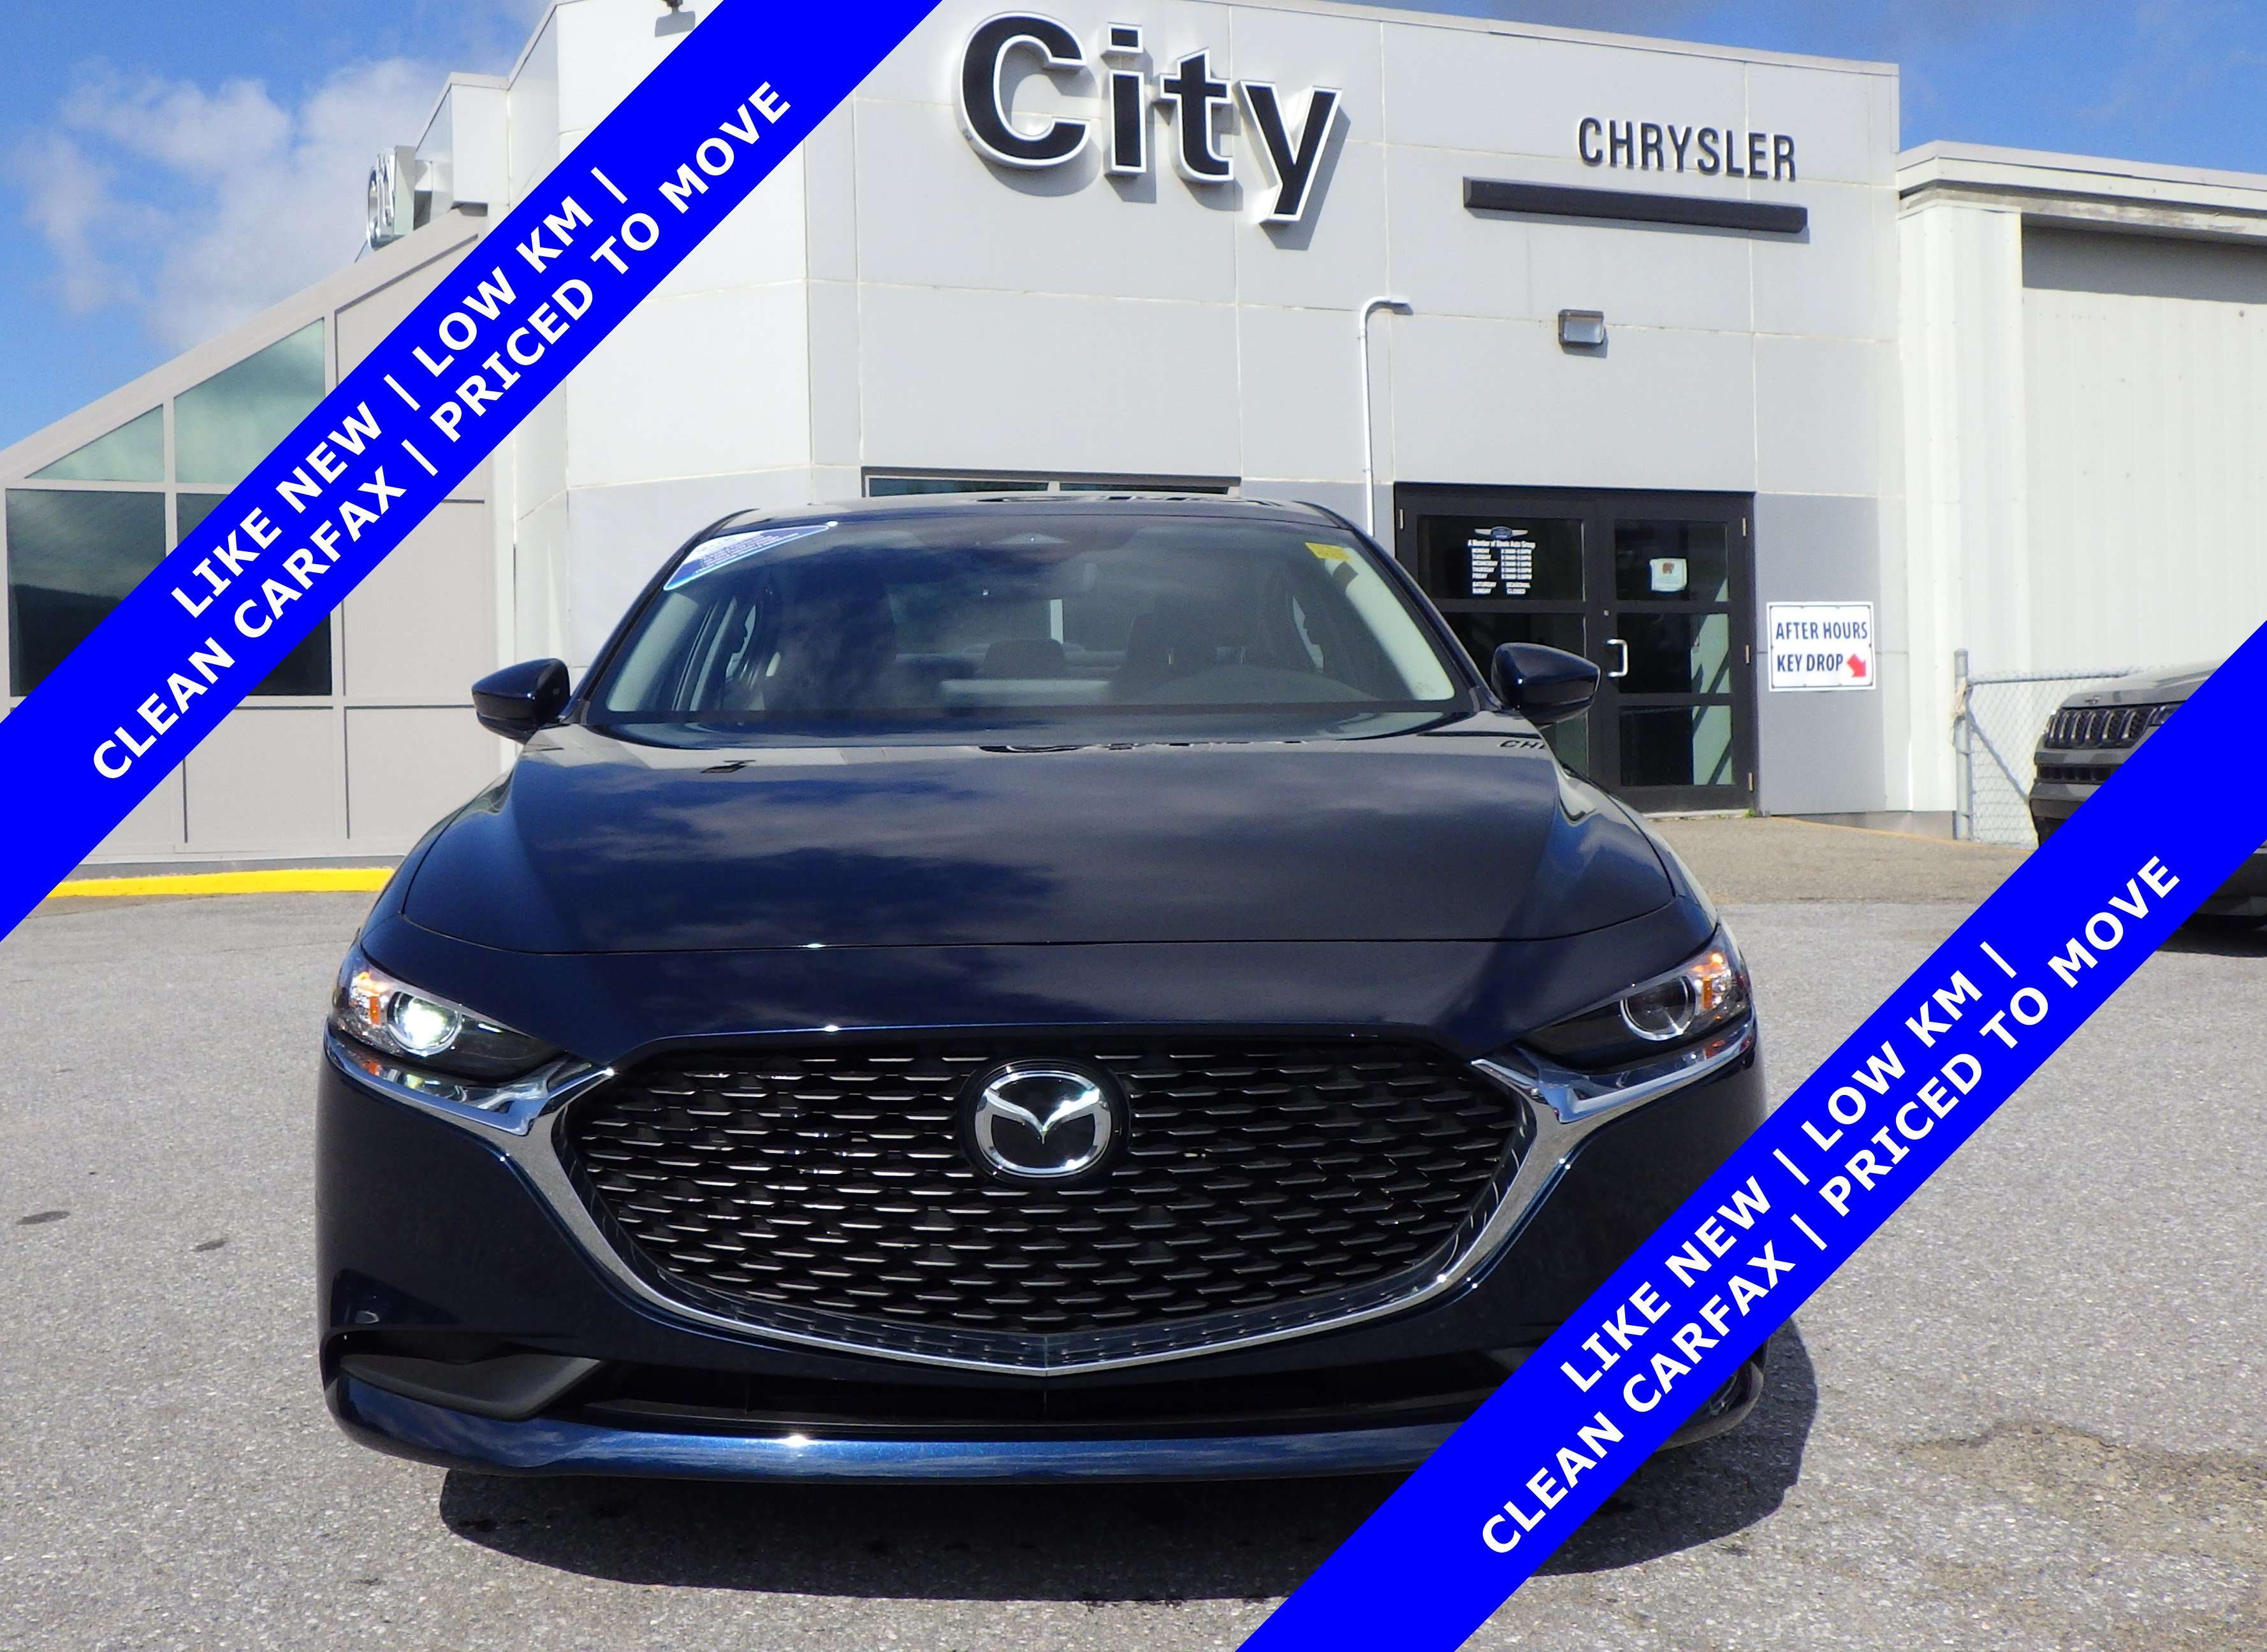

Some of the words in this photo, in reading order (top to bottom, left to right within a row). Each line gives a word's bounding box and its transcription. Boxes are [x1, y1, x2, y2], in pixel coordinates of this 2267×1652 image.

[957, 11, 1342, 221] City
[1578, 117, 1796, 182] CHRYSLER
[1776, 622, 1819, 640] AFTER
[1823, 621, 1868, 639] HOURS
[1777, 654, 1803, 672] KEY
[1806, 653, 1844, 671] DROP
